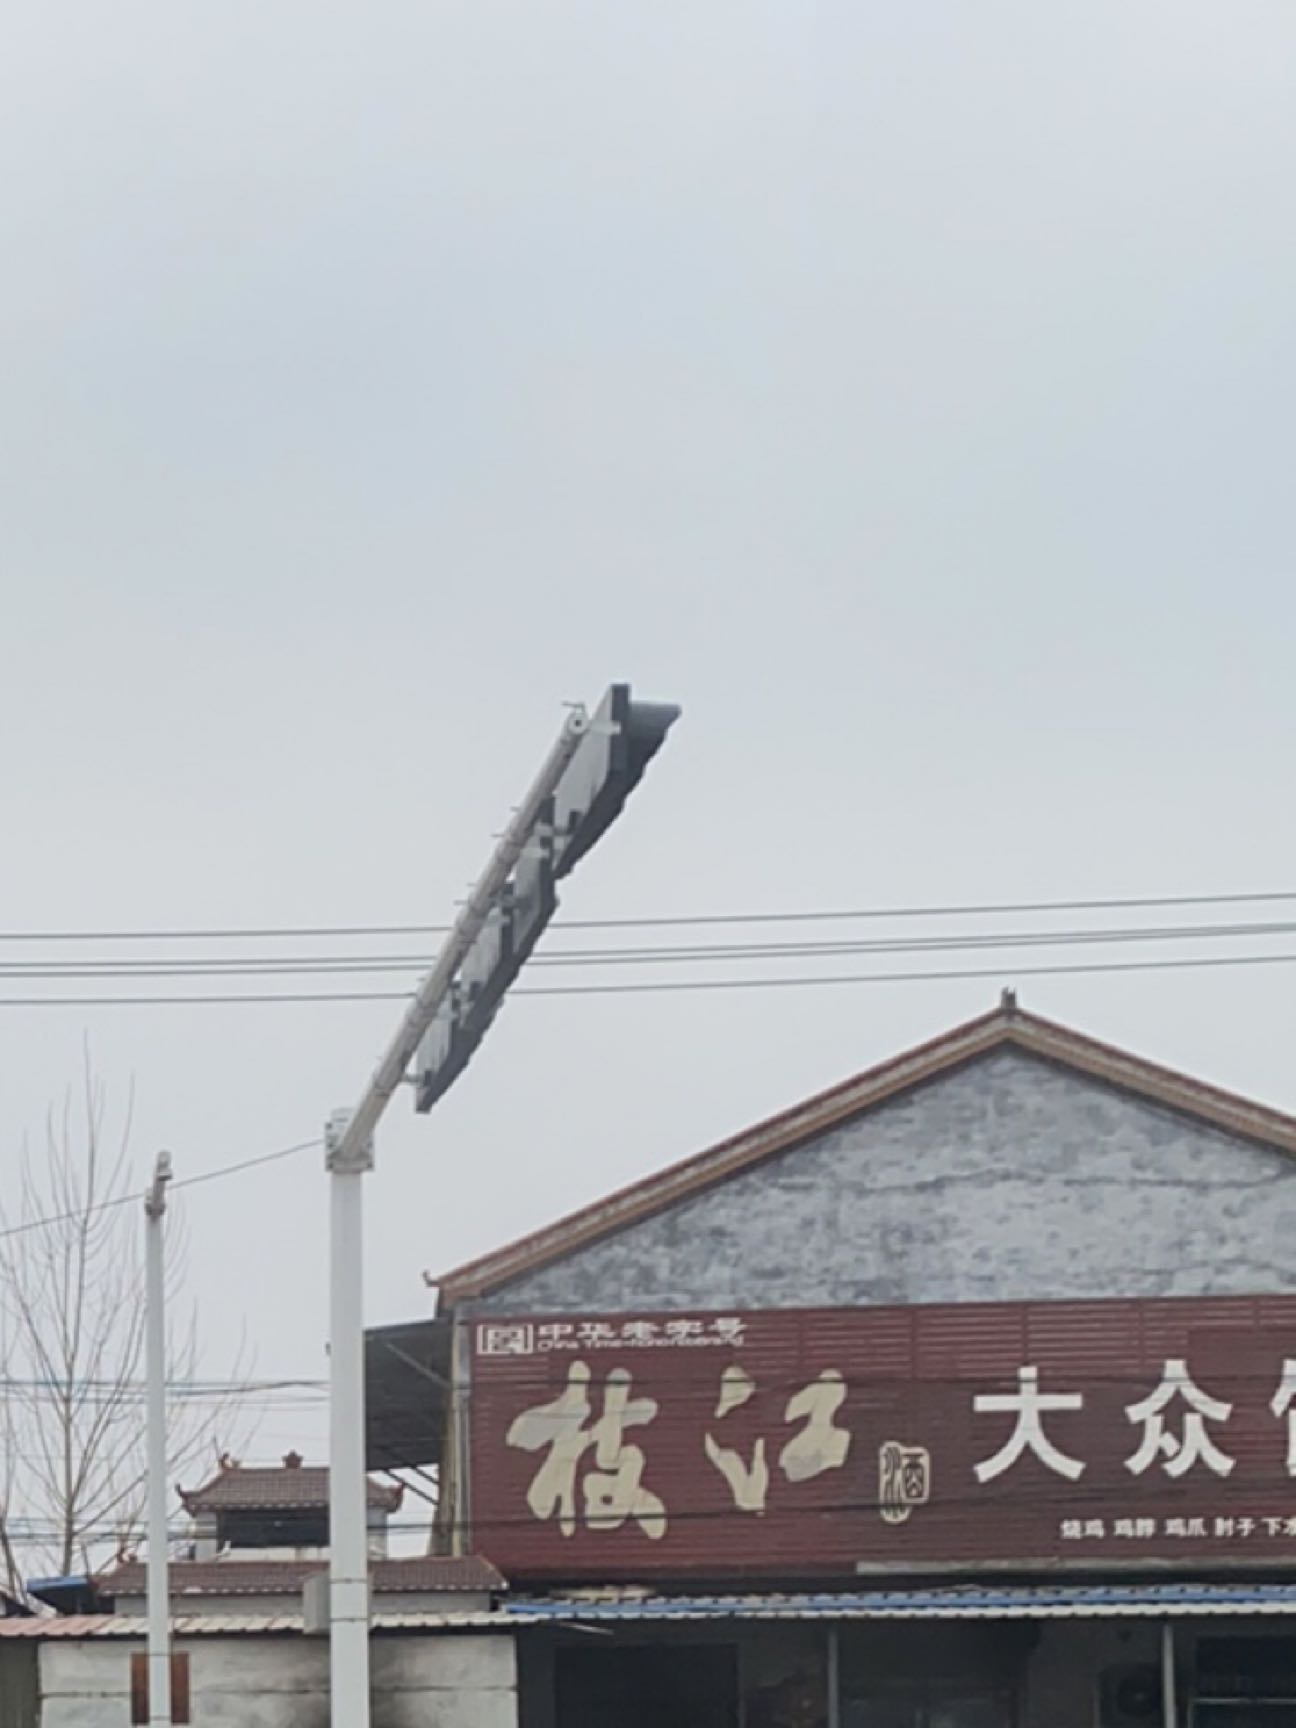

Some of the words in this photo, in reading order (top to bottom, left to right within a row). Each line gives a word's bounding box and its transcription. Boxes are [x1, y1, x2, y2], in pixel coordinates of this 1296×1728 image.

[537, 1318, 747, 1340] 中华老字号
[505, 1360, 853, 1540] 枝江
[972, 1357, 1296, 1484] 大众
